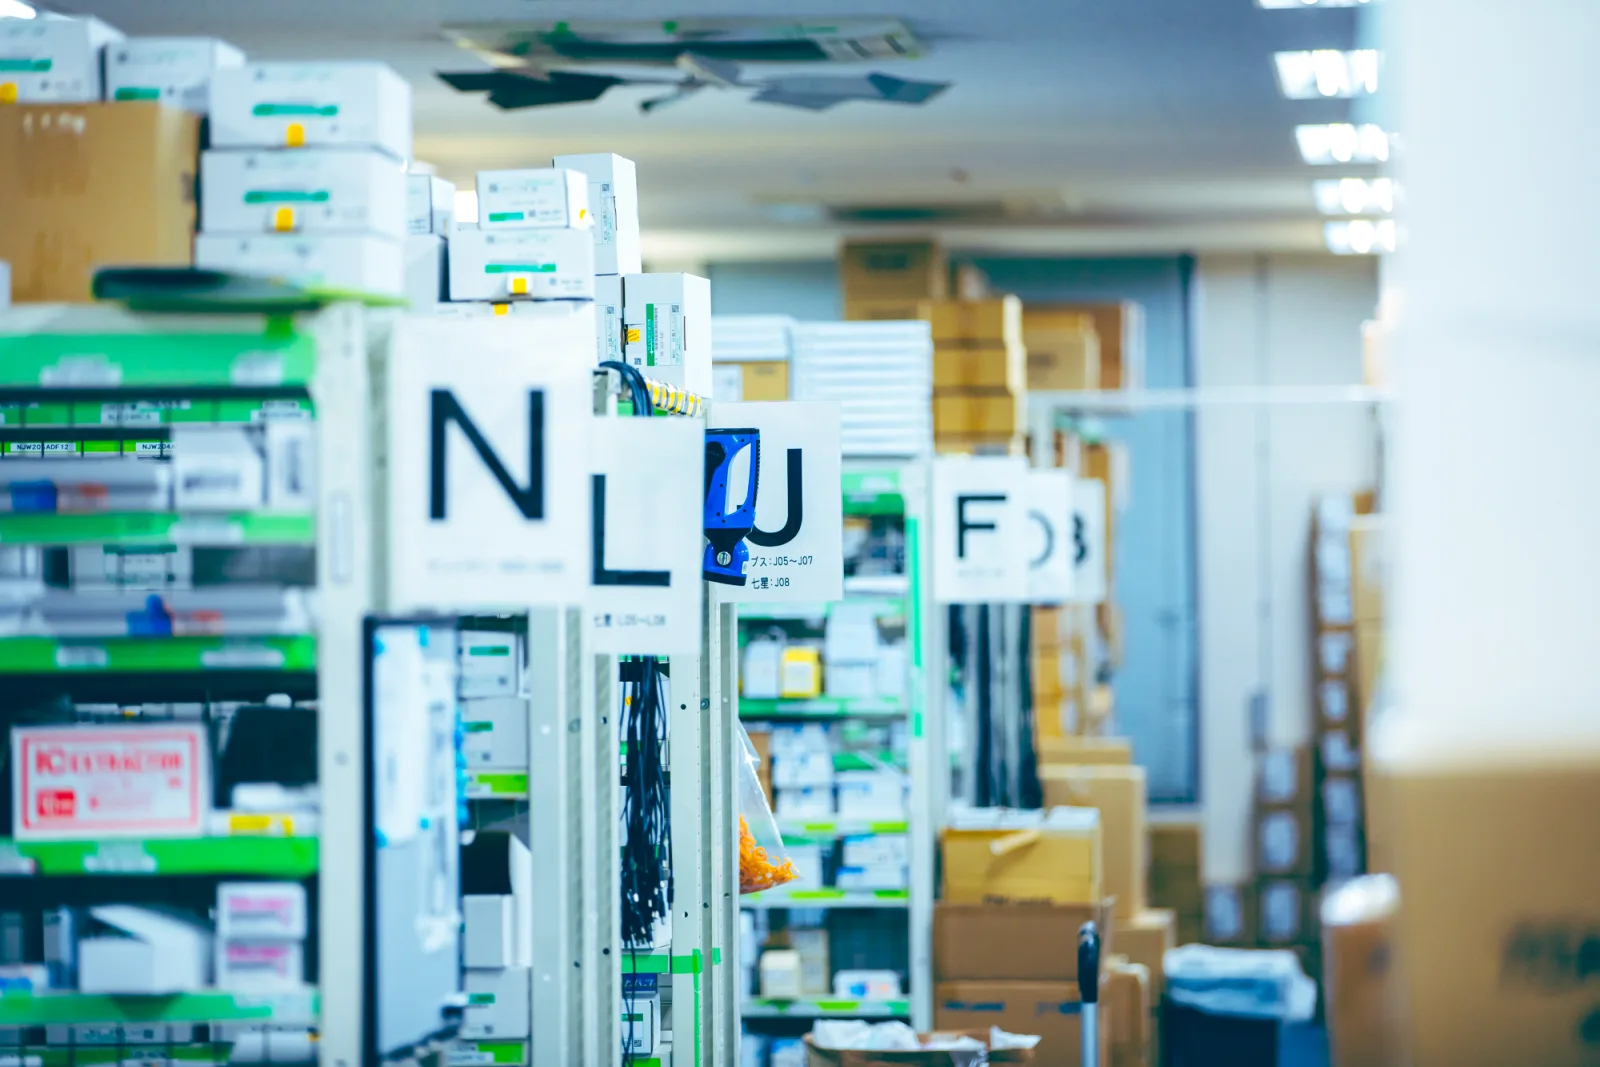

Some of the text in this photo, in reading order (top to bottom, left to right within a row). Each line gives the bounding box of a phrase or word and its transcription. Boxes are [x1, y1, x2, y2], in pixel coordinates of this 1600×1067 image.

[429, 387, 545, 521] N
[591, 474, 671, 586] L
[956, 494, 1008, 559] F
